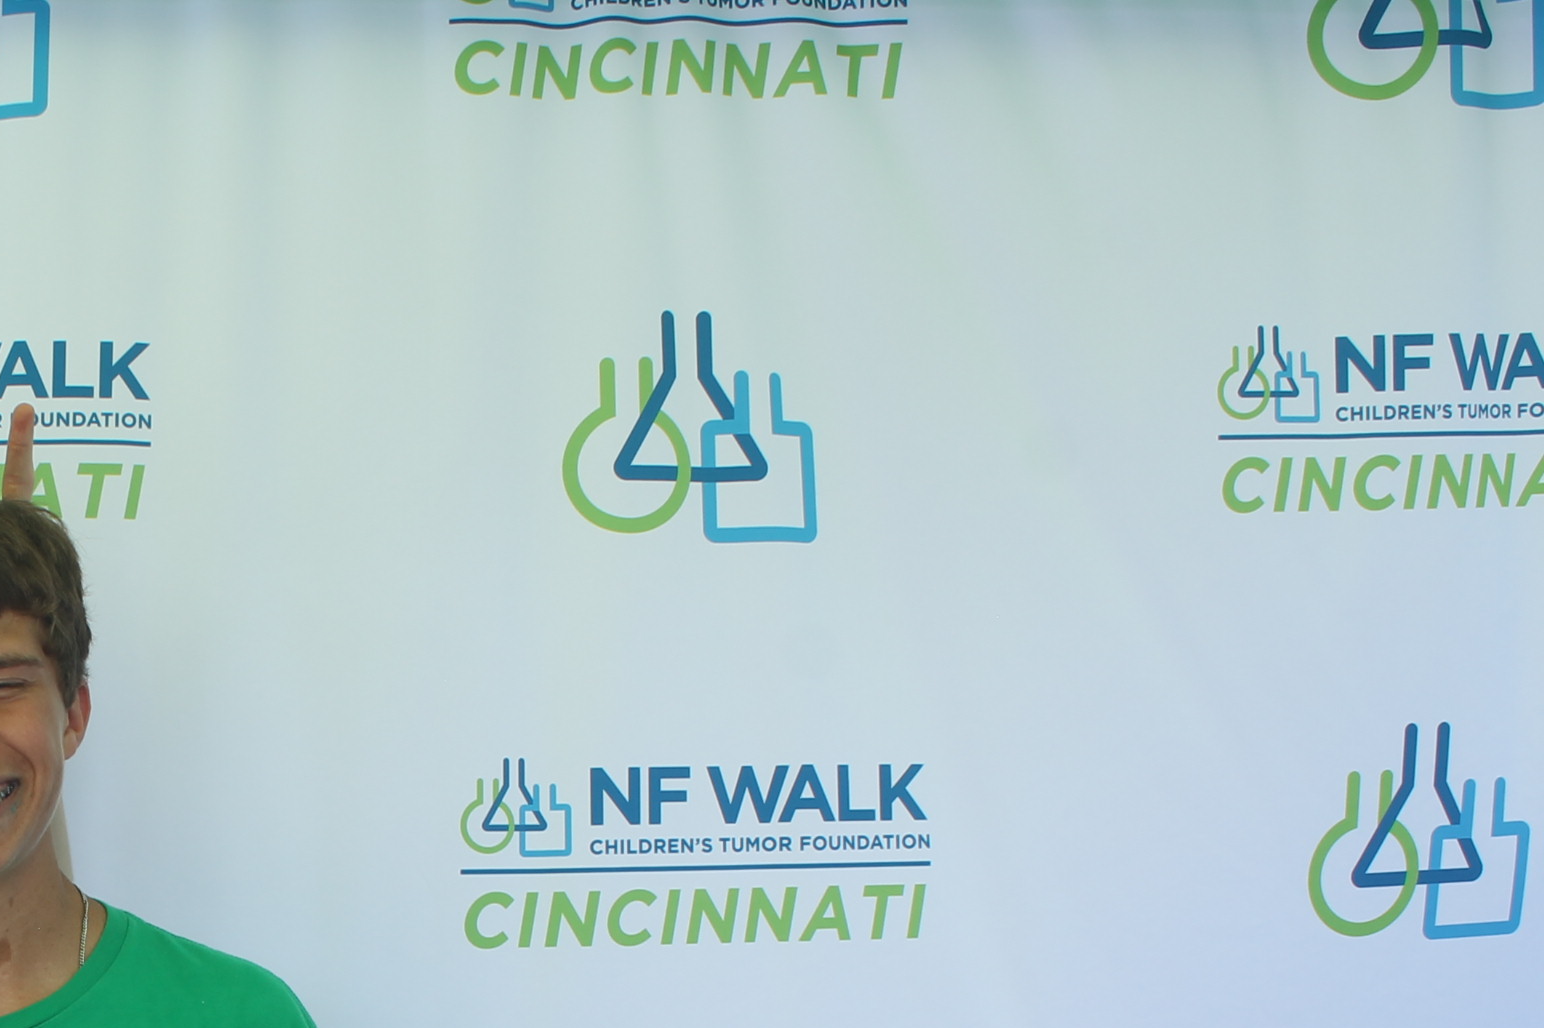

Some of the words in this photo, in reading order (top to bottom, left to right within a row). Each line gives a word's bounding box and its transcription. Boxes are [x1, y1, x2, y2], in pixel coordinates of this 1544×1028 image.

[454, 38, 903, 99] CINCINNATI
[1334, 333, 1434, 393] NF
[10, 411, 152, 430] UNDATION
[1335, 403, 1453, 422] CHILDREN'S
[1457, 403, 1512, 420] TUMOR
[589, 765, 691, 826] NF
[706, 763, 928, 825] WALK
[589, 837, 714, 856] CHILDREN'S
[719, 836, 793, 853] TUMOR
[799, 833, 932, 852] FOUNDATION
[463, 883, 927, 950] CINCINNATI
